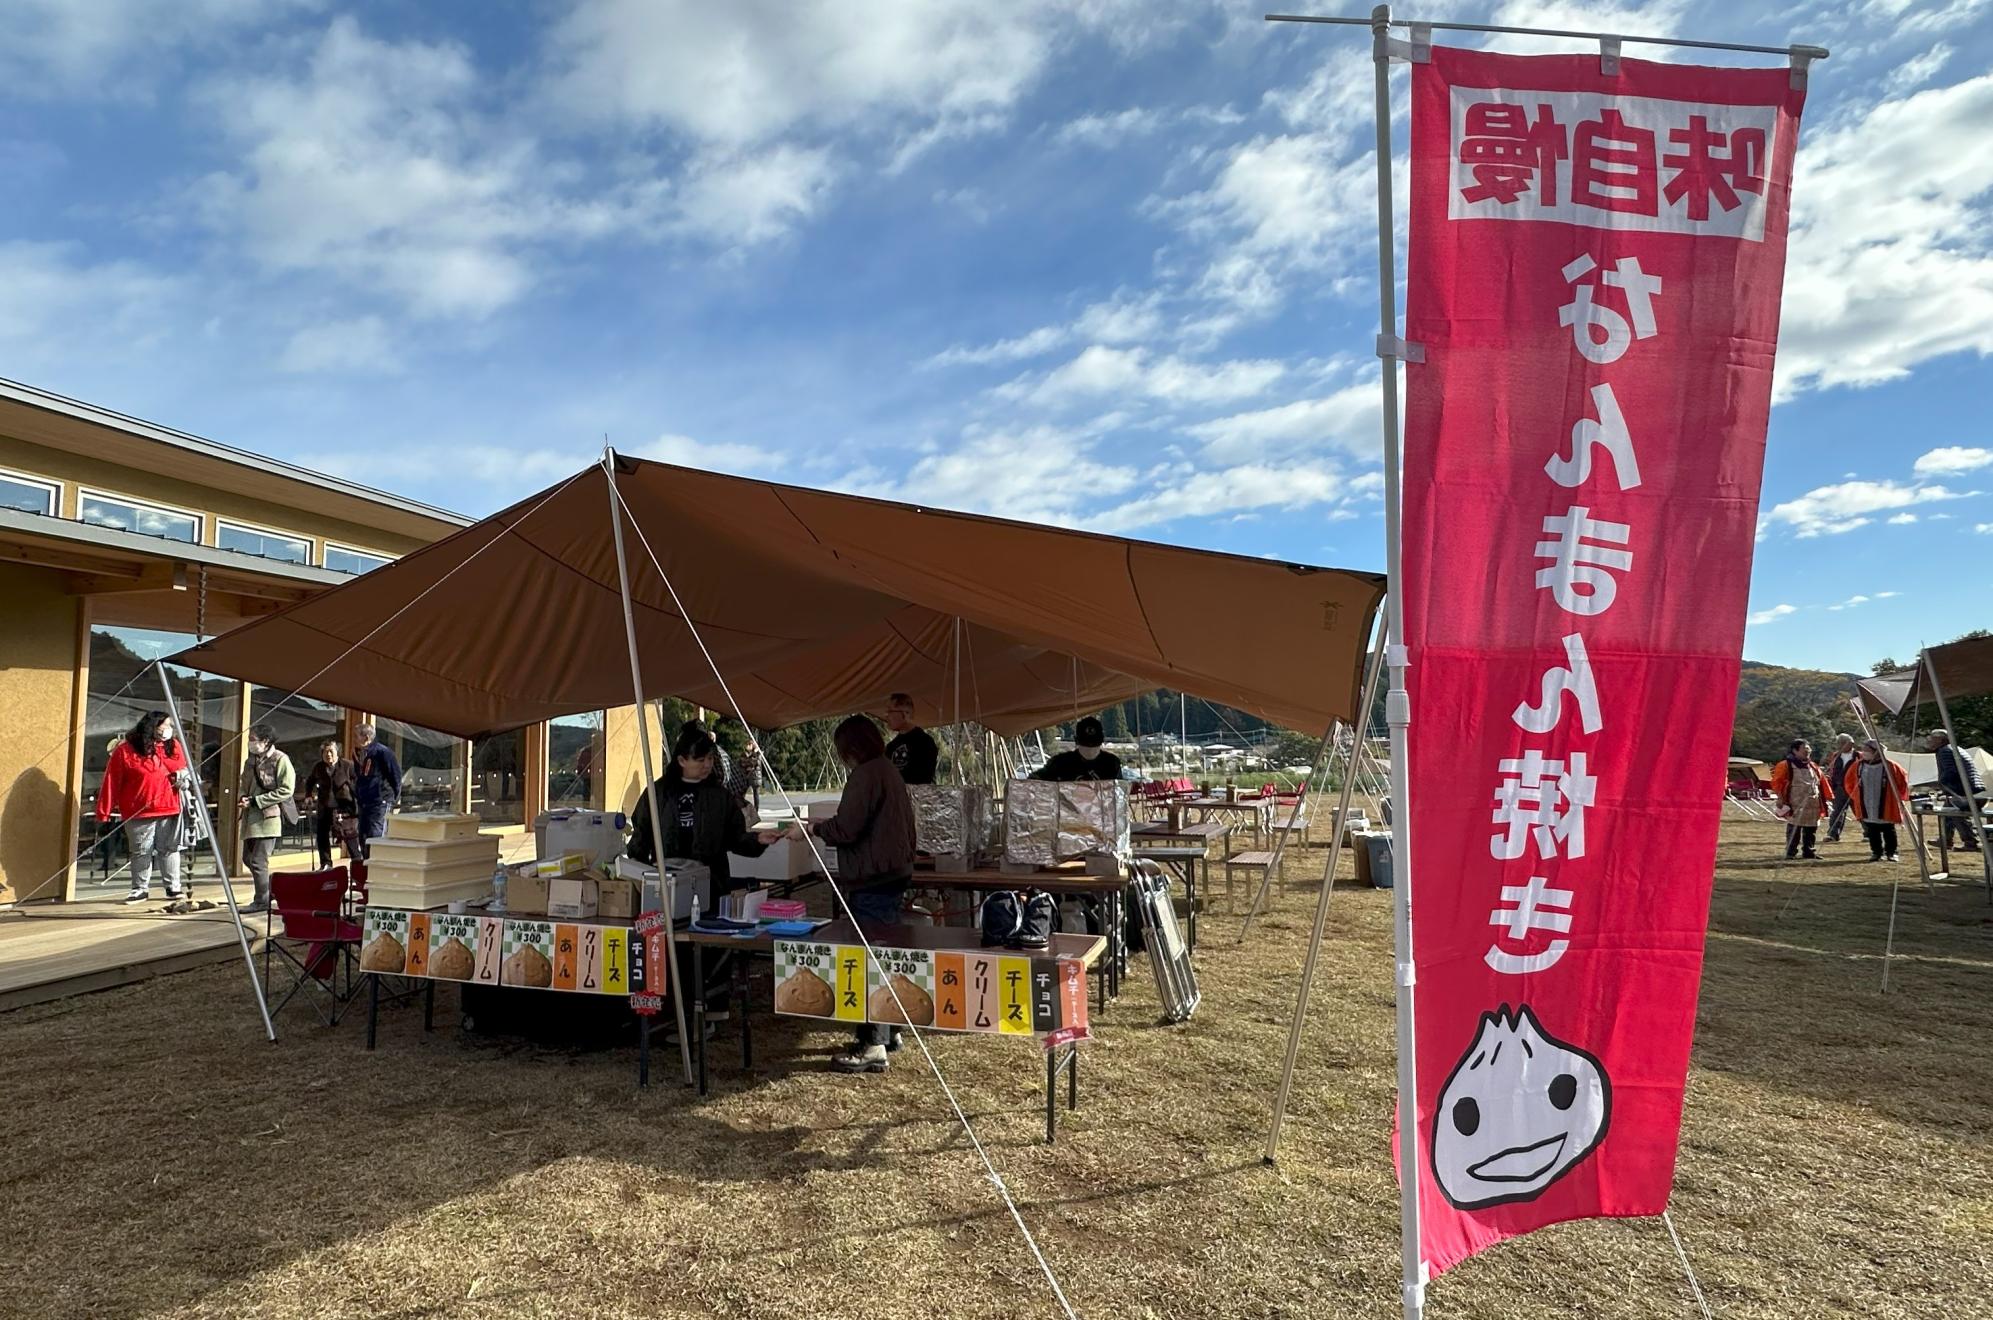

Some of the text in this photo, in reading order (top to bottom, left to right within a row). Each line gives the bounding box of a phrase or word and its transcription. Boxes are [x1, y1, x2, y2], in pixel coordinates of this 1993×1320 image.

[376, 922, 398, 932] ¥300
[411, 927, 424, 965] あん
[516, 932, 542, 944] ¥300
[480, 922, 495, 980] クリーム
[559, 938, 572, 978] あん
[583, 930, 596, 988] クリーム
[608, 938, 620, 982] チーズ
[632, 942, 643, 981] チョコ
[790, 956, 820, 967] ¥300
[884, 962, 917, 974] ¥300
[843, 959, 858, 1008] チーズ
[942, 969, 958, 1015] あん
[974, 960, 991, 1028] クリーム
[1006, 970, 1023, 1021] チーズ
[1036, 973, 1051, 1017] チョコ
